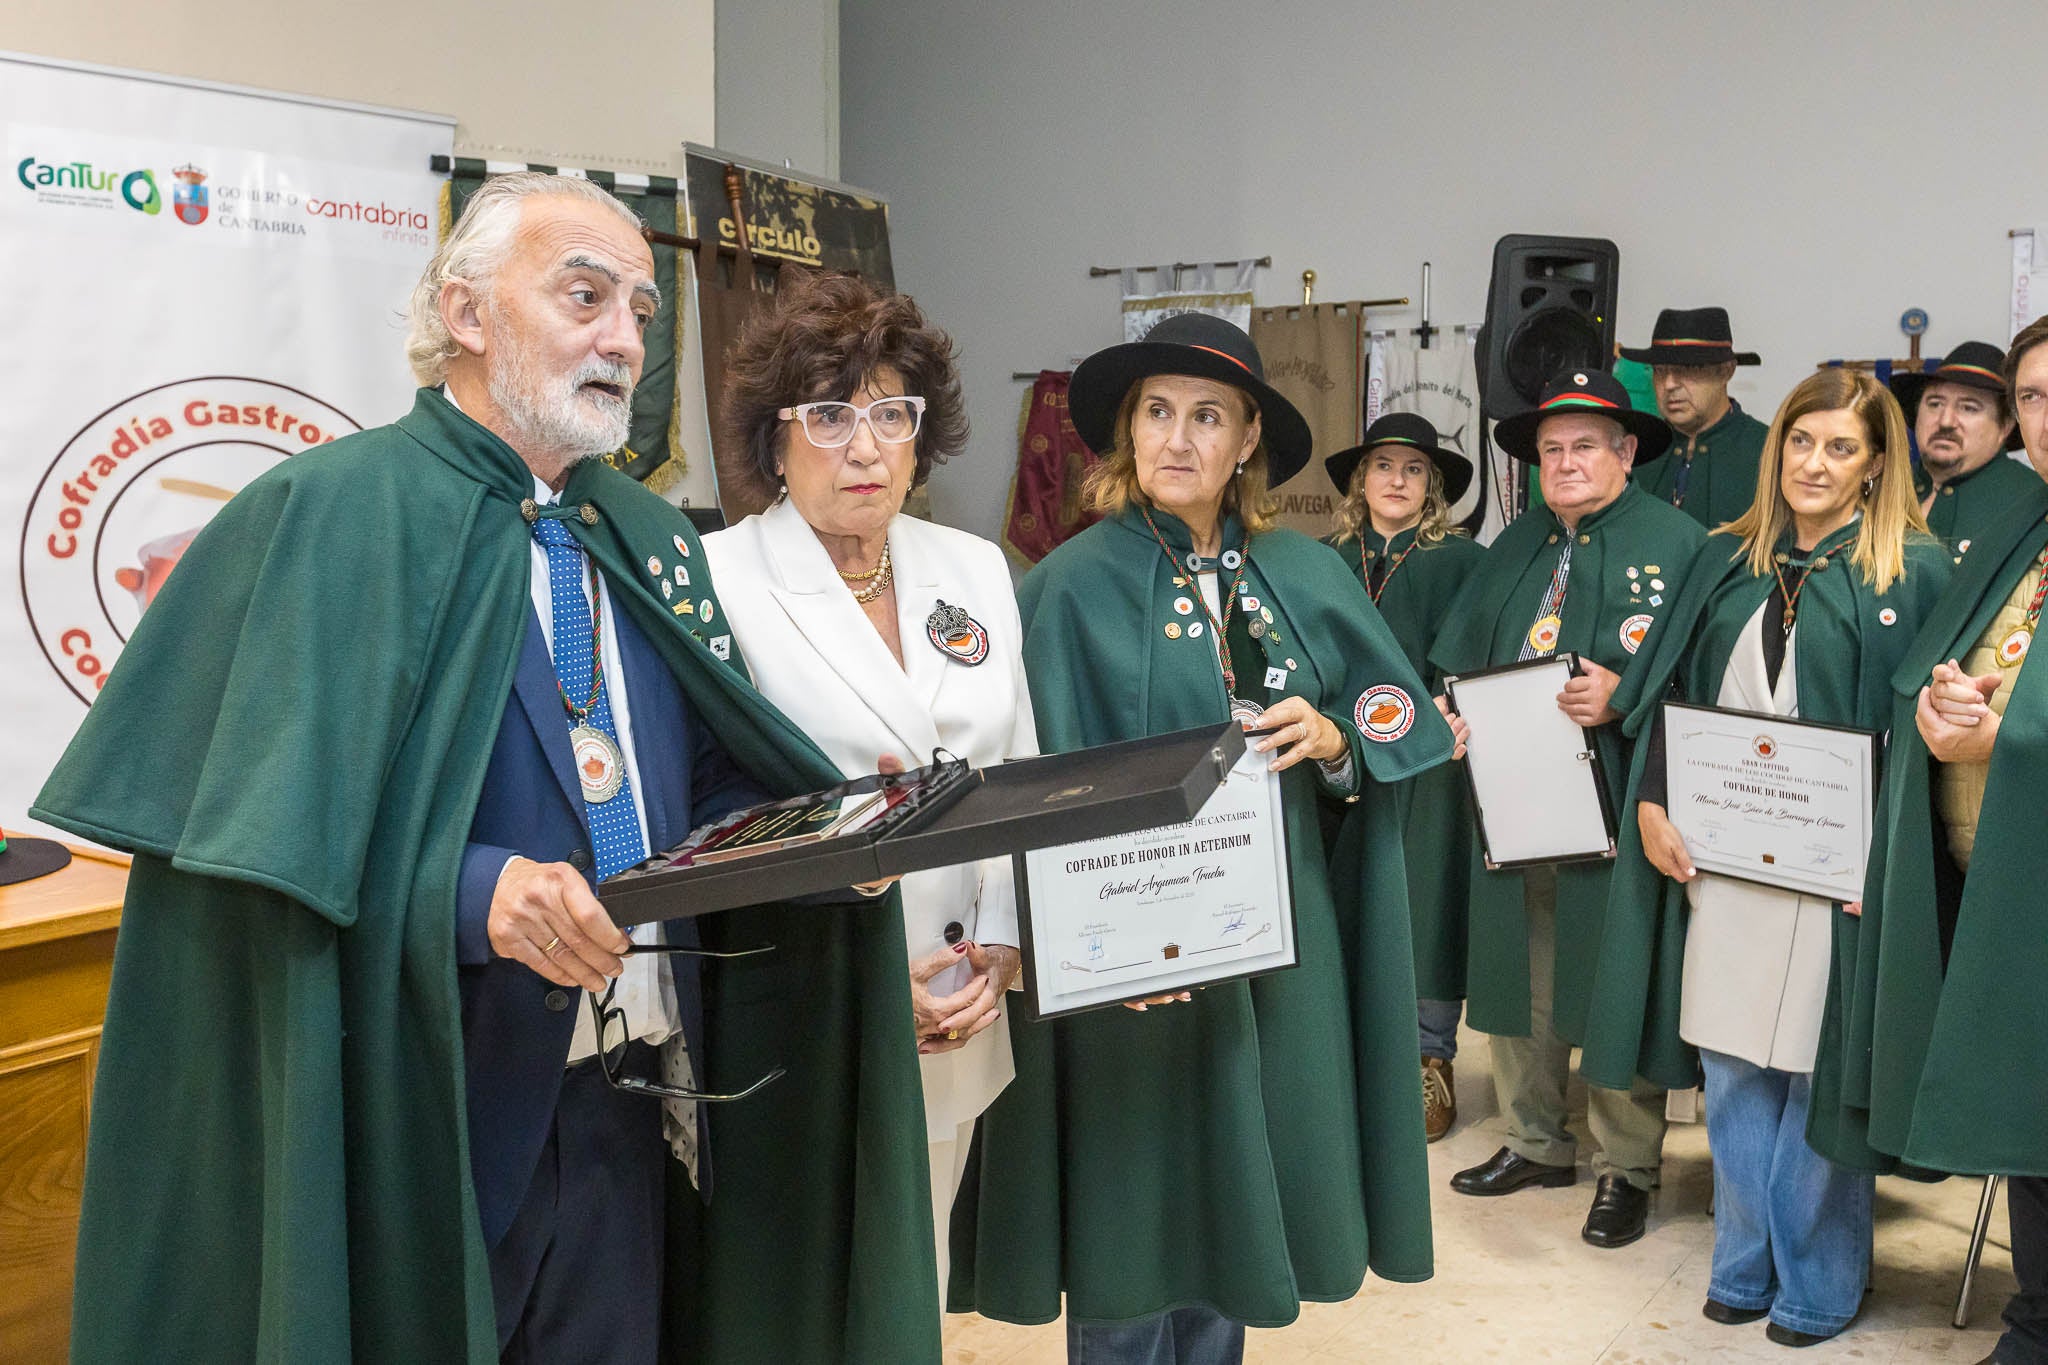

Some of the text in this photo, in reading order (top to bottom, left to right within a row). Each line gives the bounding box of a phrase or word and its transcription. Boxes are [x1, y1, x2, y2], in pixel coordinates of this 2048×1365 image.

[18, 157, 119, 192] CanTur
[306, 198, 428, 230] cantabria
[718, 217, 821, 256] crculo
[47, 416, 174, 559] Cofradía
[1723, 780, 1763, 796] COFRADE
[1765, 787, 1777, 798] DE
[1779, 789, 1809, 803] HONOR
[1195, 817, 1207, 827] DE
[1208, 810, 1257, 825] CANTABRIA
[1066, 834, 1251, 874] COFRADE DE HONOR IN AETERNUM
[1099, 878, 1141, 899] Gabriel
[1139, 874, 1190, 896] Argumosa
[1192, 865, 1226, 884] Trueba
